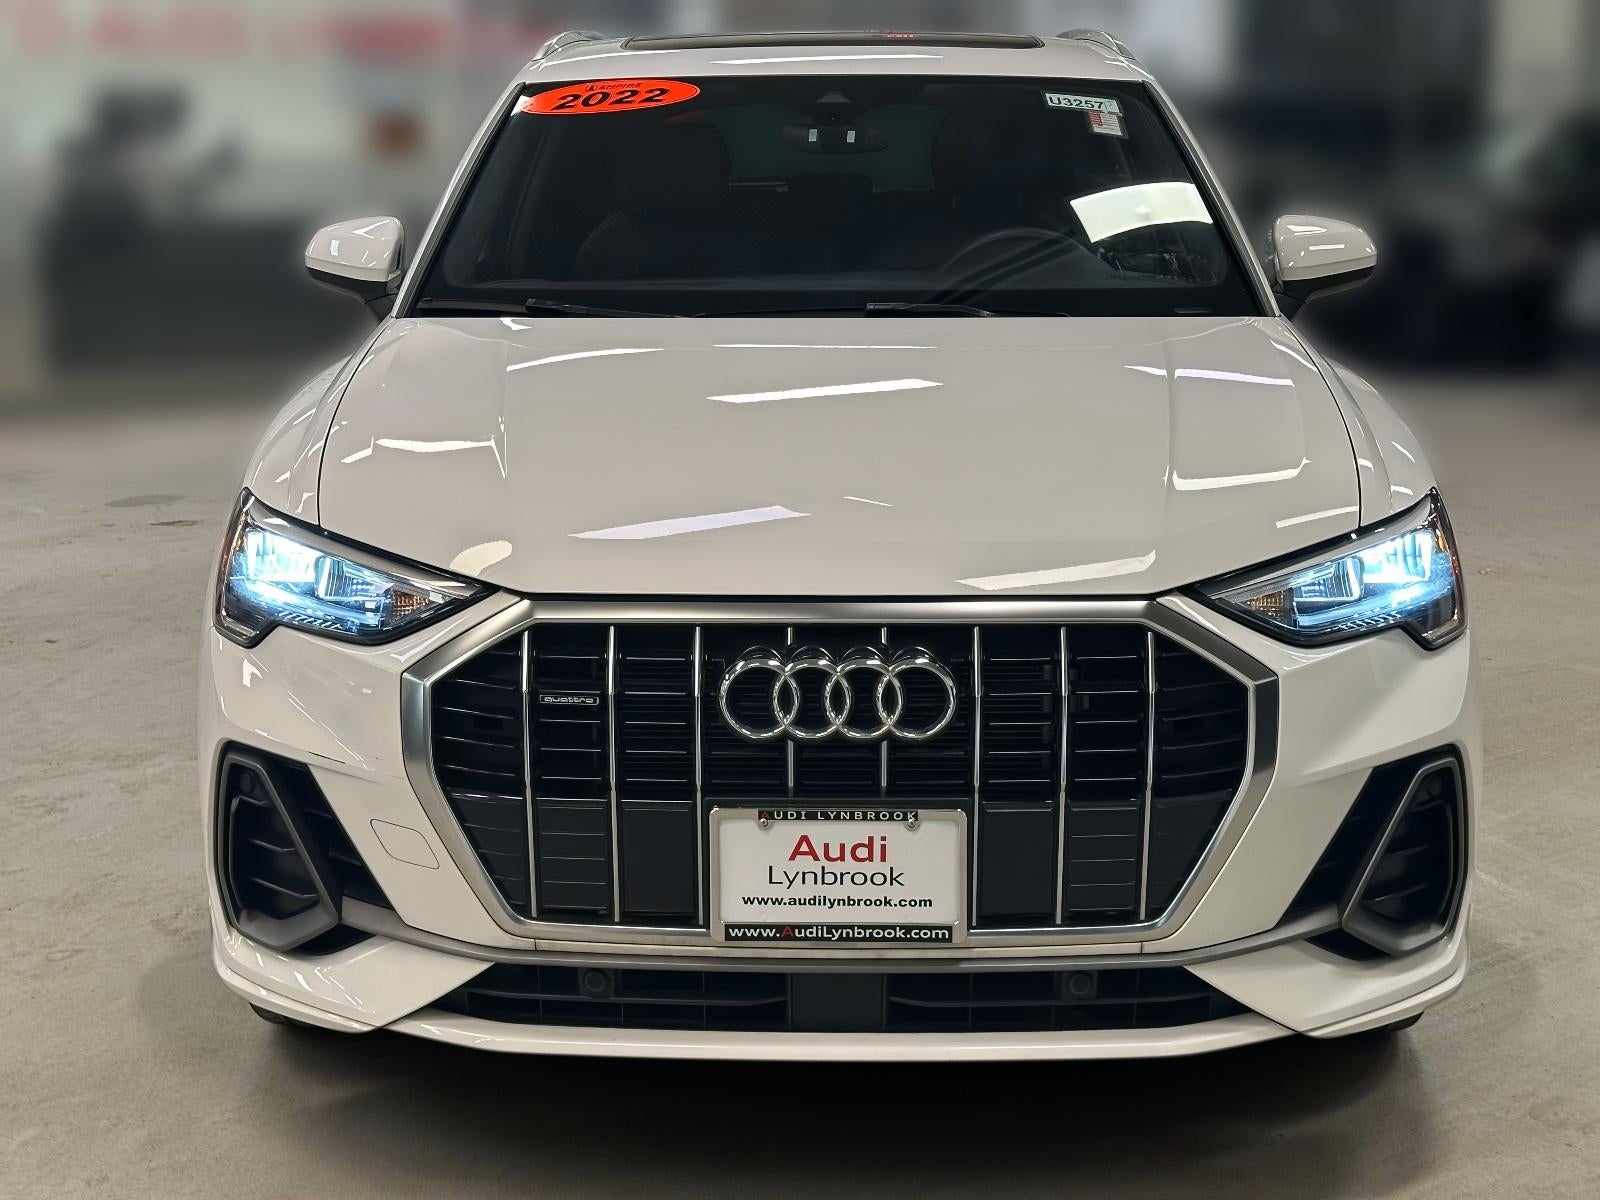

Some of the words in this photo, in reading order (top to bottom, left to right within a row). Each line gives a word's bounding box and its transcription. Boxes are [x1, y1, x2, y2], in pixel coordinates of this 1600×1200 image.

[551, 88, 670, 111] 2022
[544, 696, 594, 704] quattro
[760, 811, 807, 821] AUDI
[817, 811, 918, 821] LYNBROOK
[788, 834, 887, 863] Audi
[768, 865, 905, 889] Lynbrook
[742, 895, 933, 909] www.audilynbrook.com
[728, 925, 949, 941] www.AudiLynbrook.com
